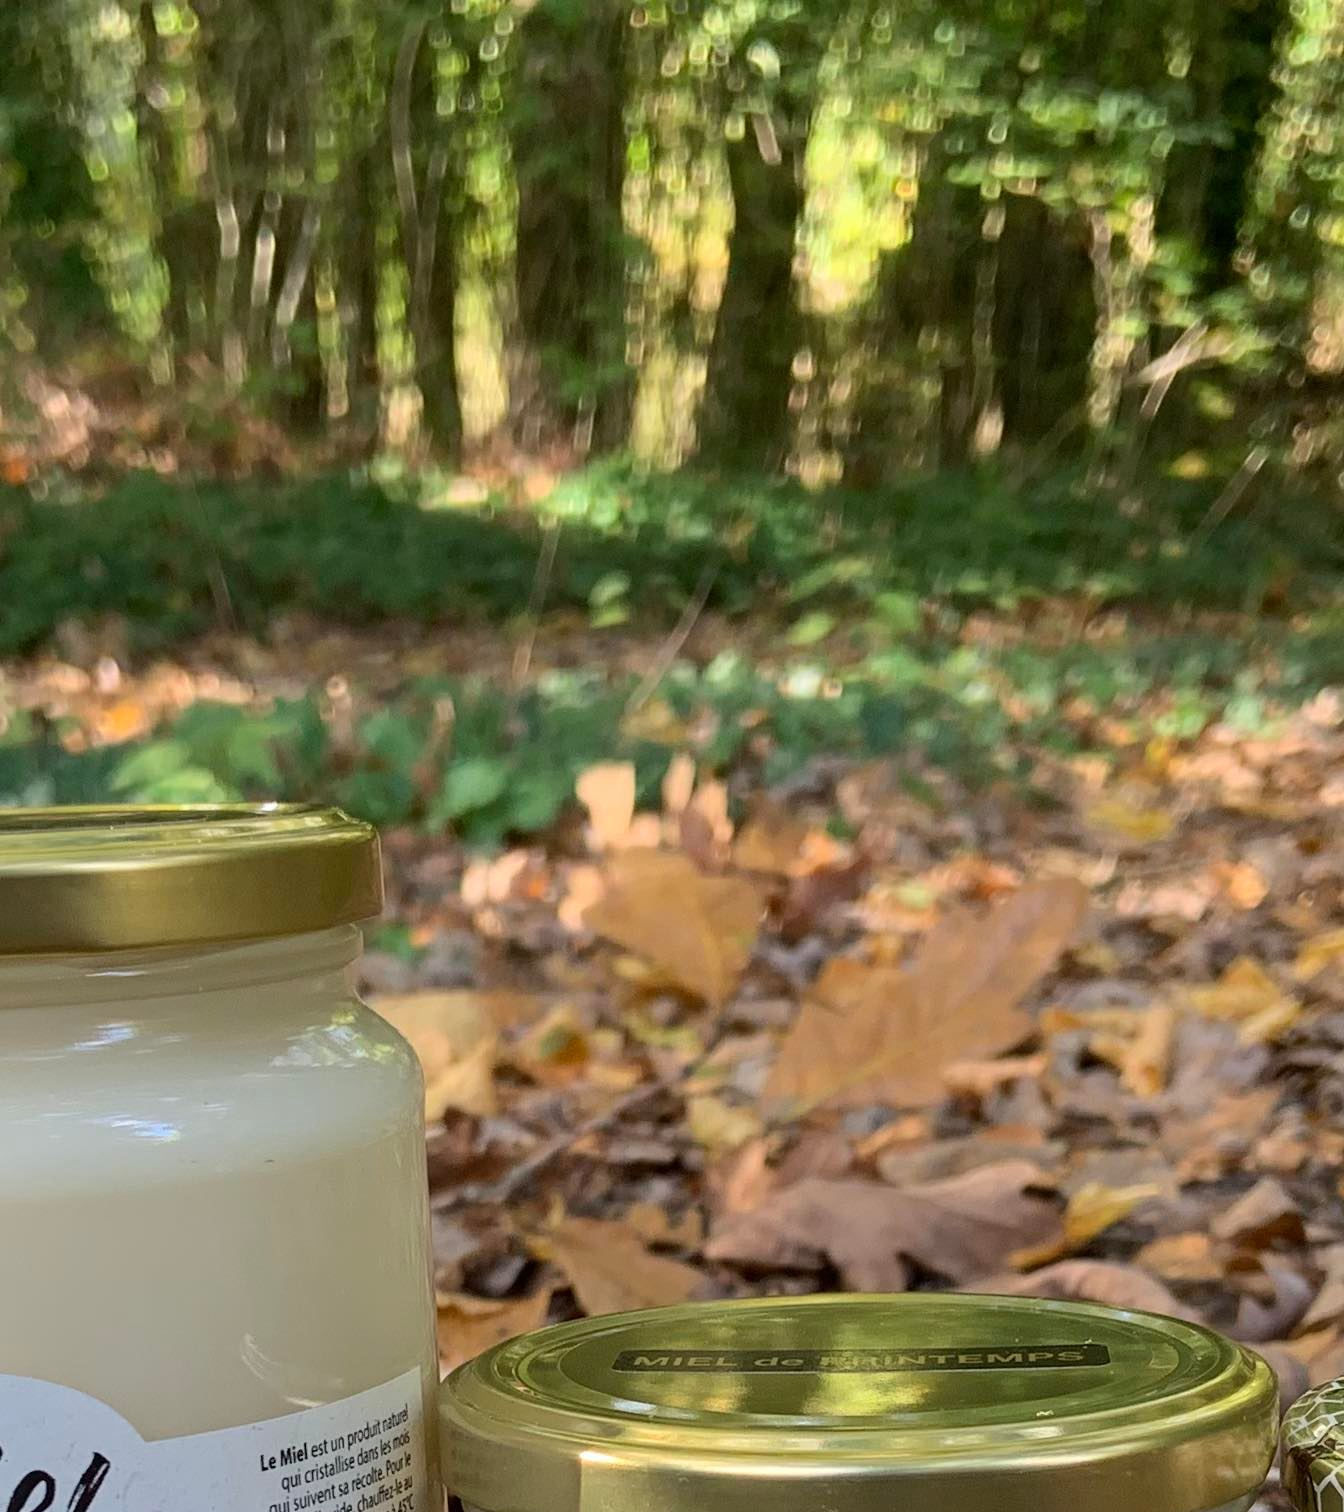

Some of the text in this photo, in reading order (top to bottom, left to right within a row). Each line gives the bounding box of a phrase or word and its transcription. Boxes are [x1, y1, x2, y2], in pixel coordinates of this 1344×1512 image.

[632, 1350, 1085, 1369] MIEL de PRINTEMPS
[260, 1454, 276, 1472] Le
[280, 1442, 308, 1468] Miel
[311, 1441, 328, 1459] est
[331, 1436, 345, 1452] un
[347, 1421, 381, 1451] produit
[281, 1429, 410, 1493] qui cristallise dans les mois
[294, 1484, 336, 1508] suivent
[338, 1482, 350, 1497] sa
[351, 1465, 385, 1492] récolte.
[386, 1456, 404, 1479] Pour
